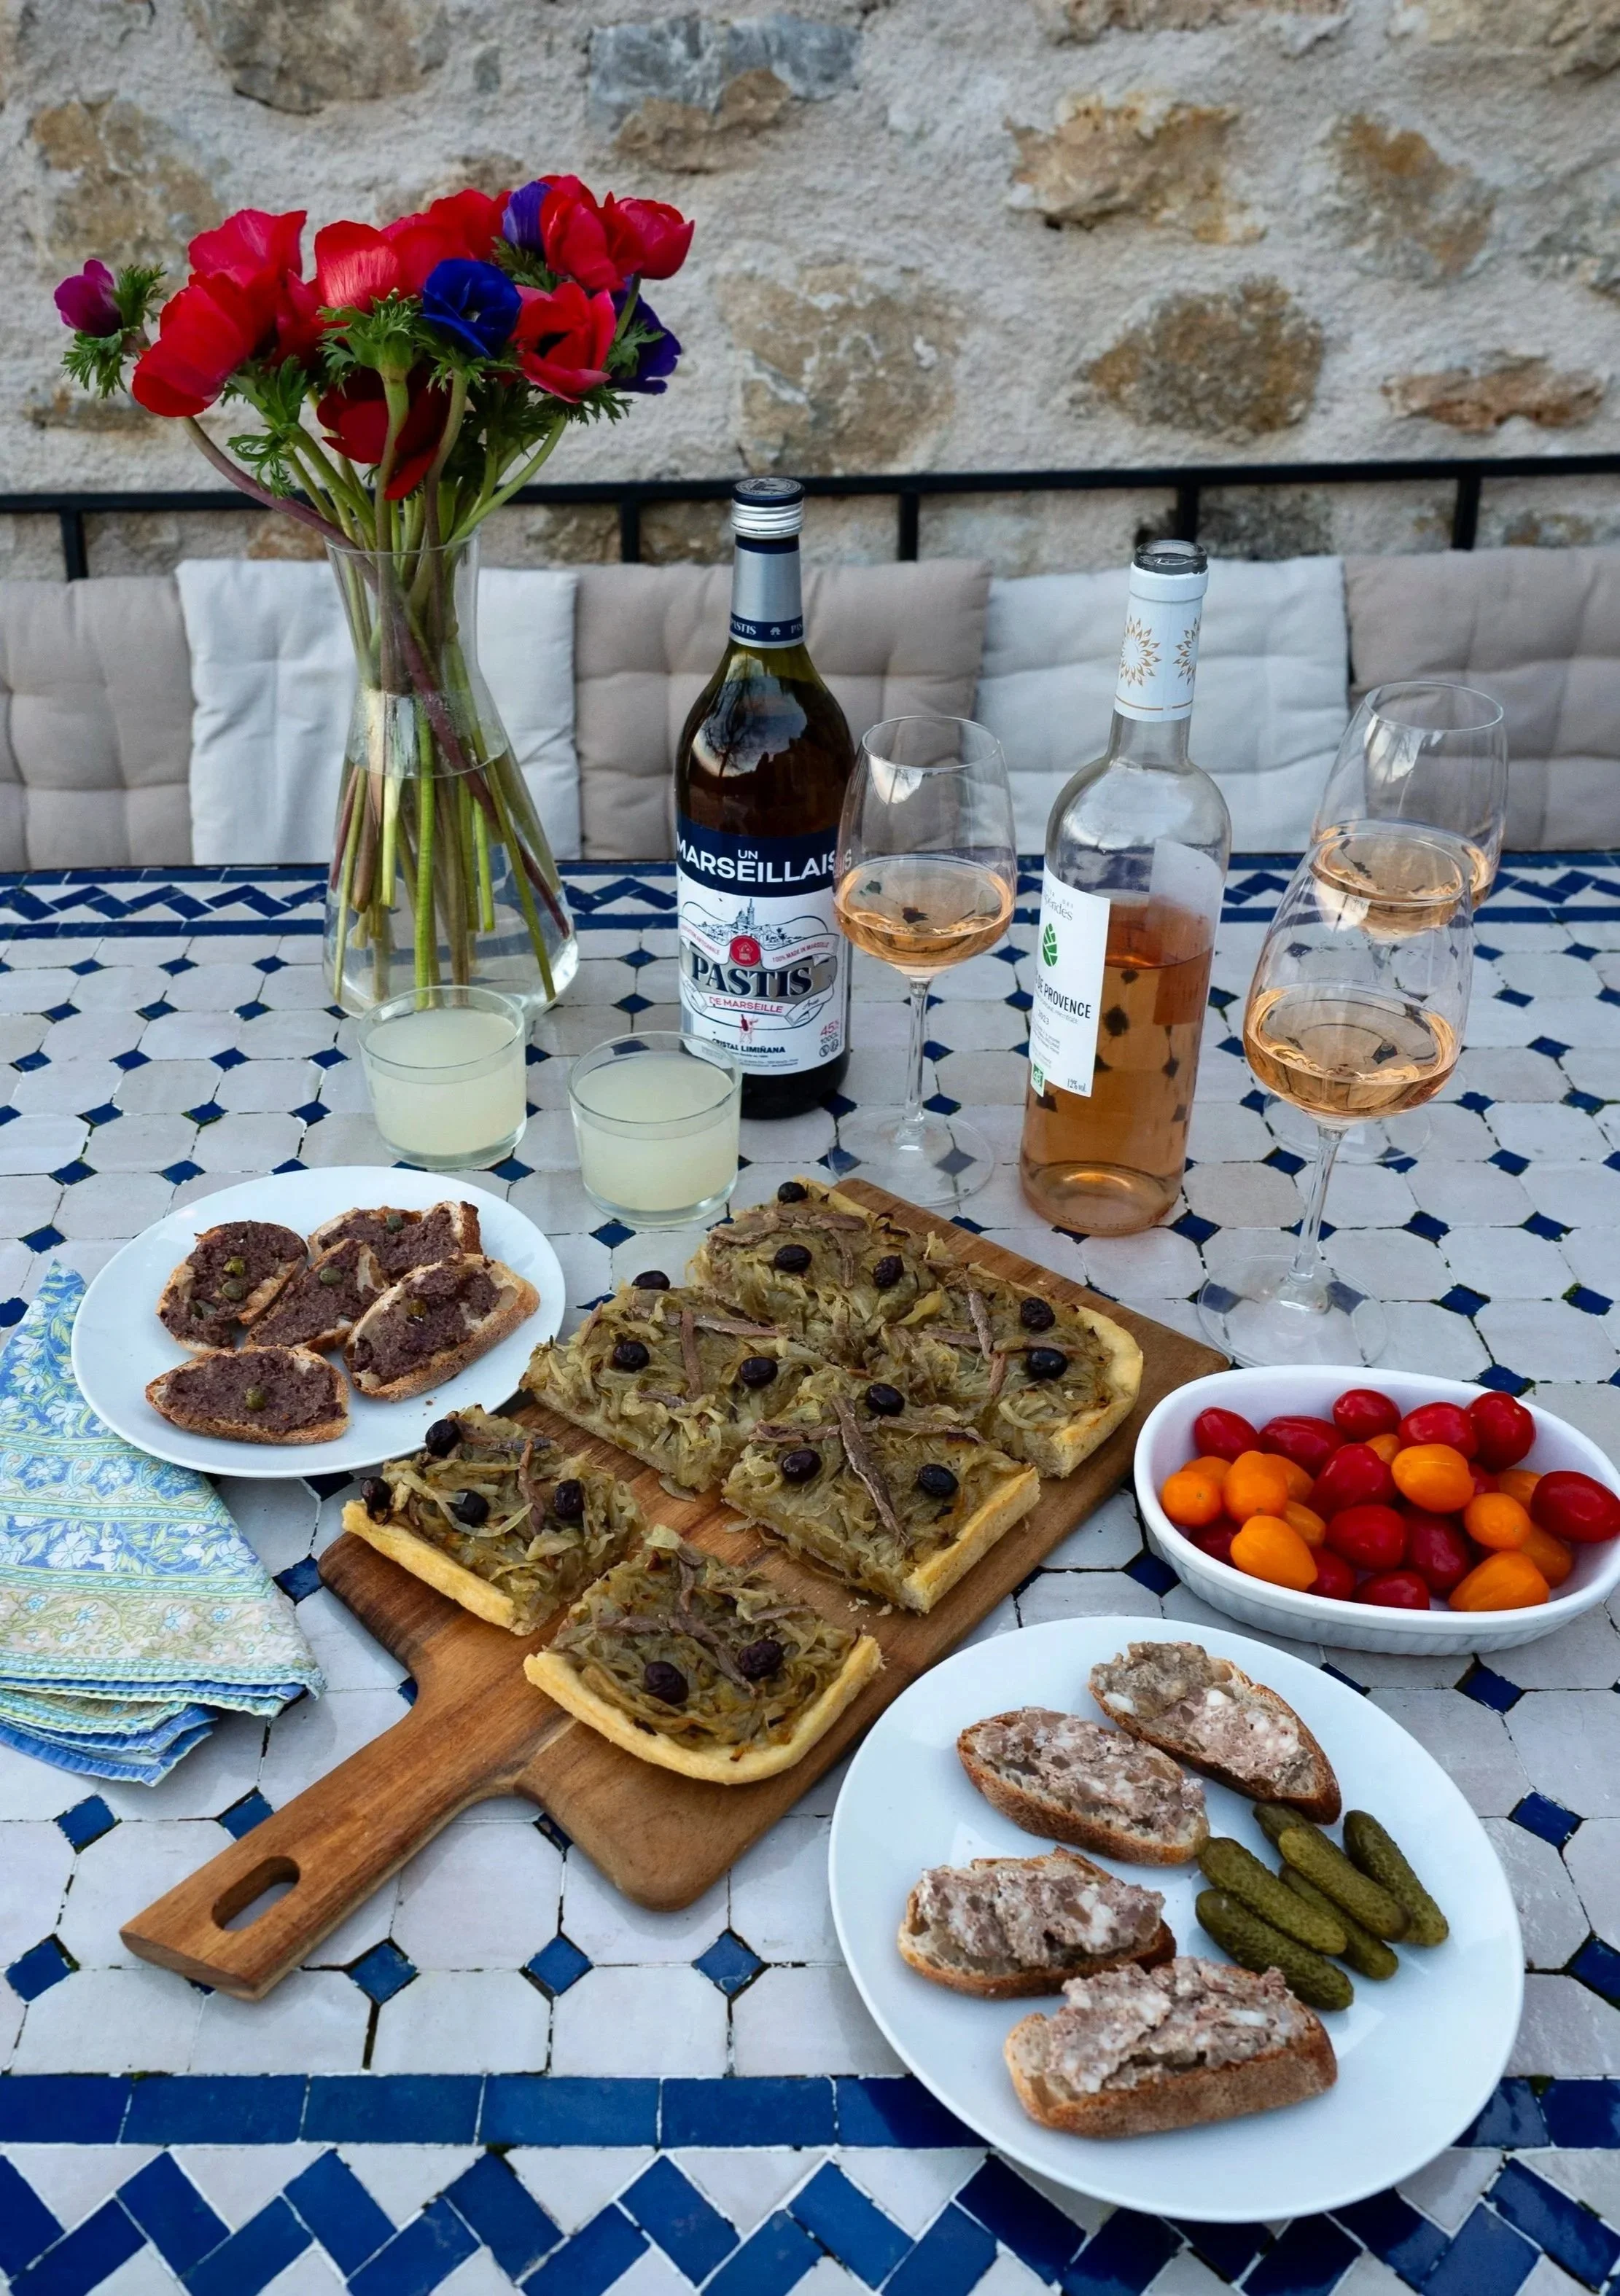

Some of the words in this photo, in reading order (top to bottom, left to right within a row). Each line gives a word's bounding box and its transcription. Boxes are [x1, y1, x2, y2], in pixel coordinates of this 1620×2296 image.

[738, 849, 758, 860] UN
[692, 951, 812, 998] PASTIS
[709, 996, 721, 1006] DE
[723, 998, 784, 1013] MARSEILLE
[1044, 983, 1091, 1019] PROVENCE
[741, 1044, 786, 1054] LIMIÑANA
